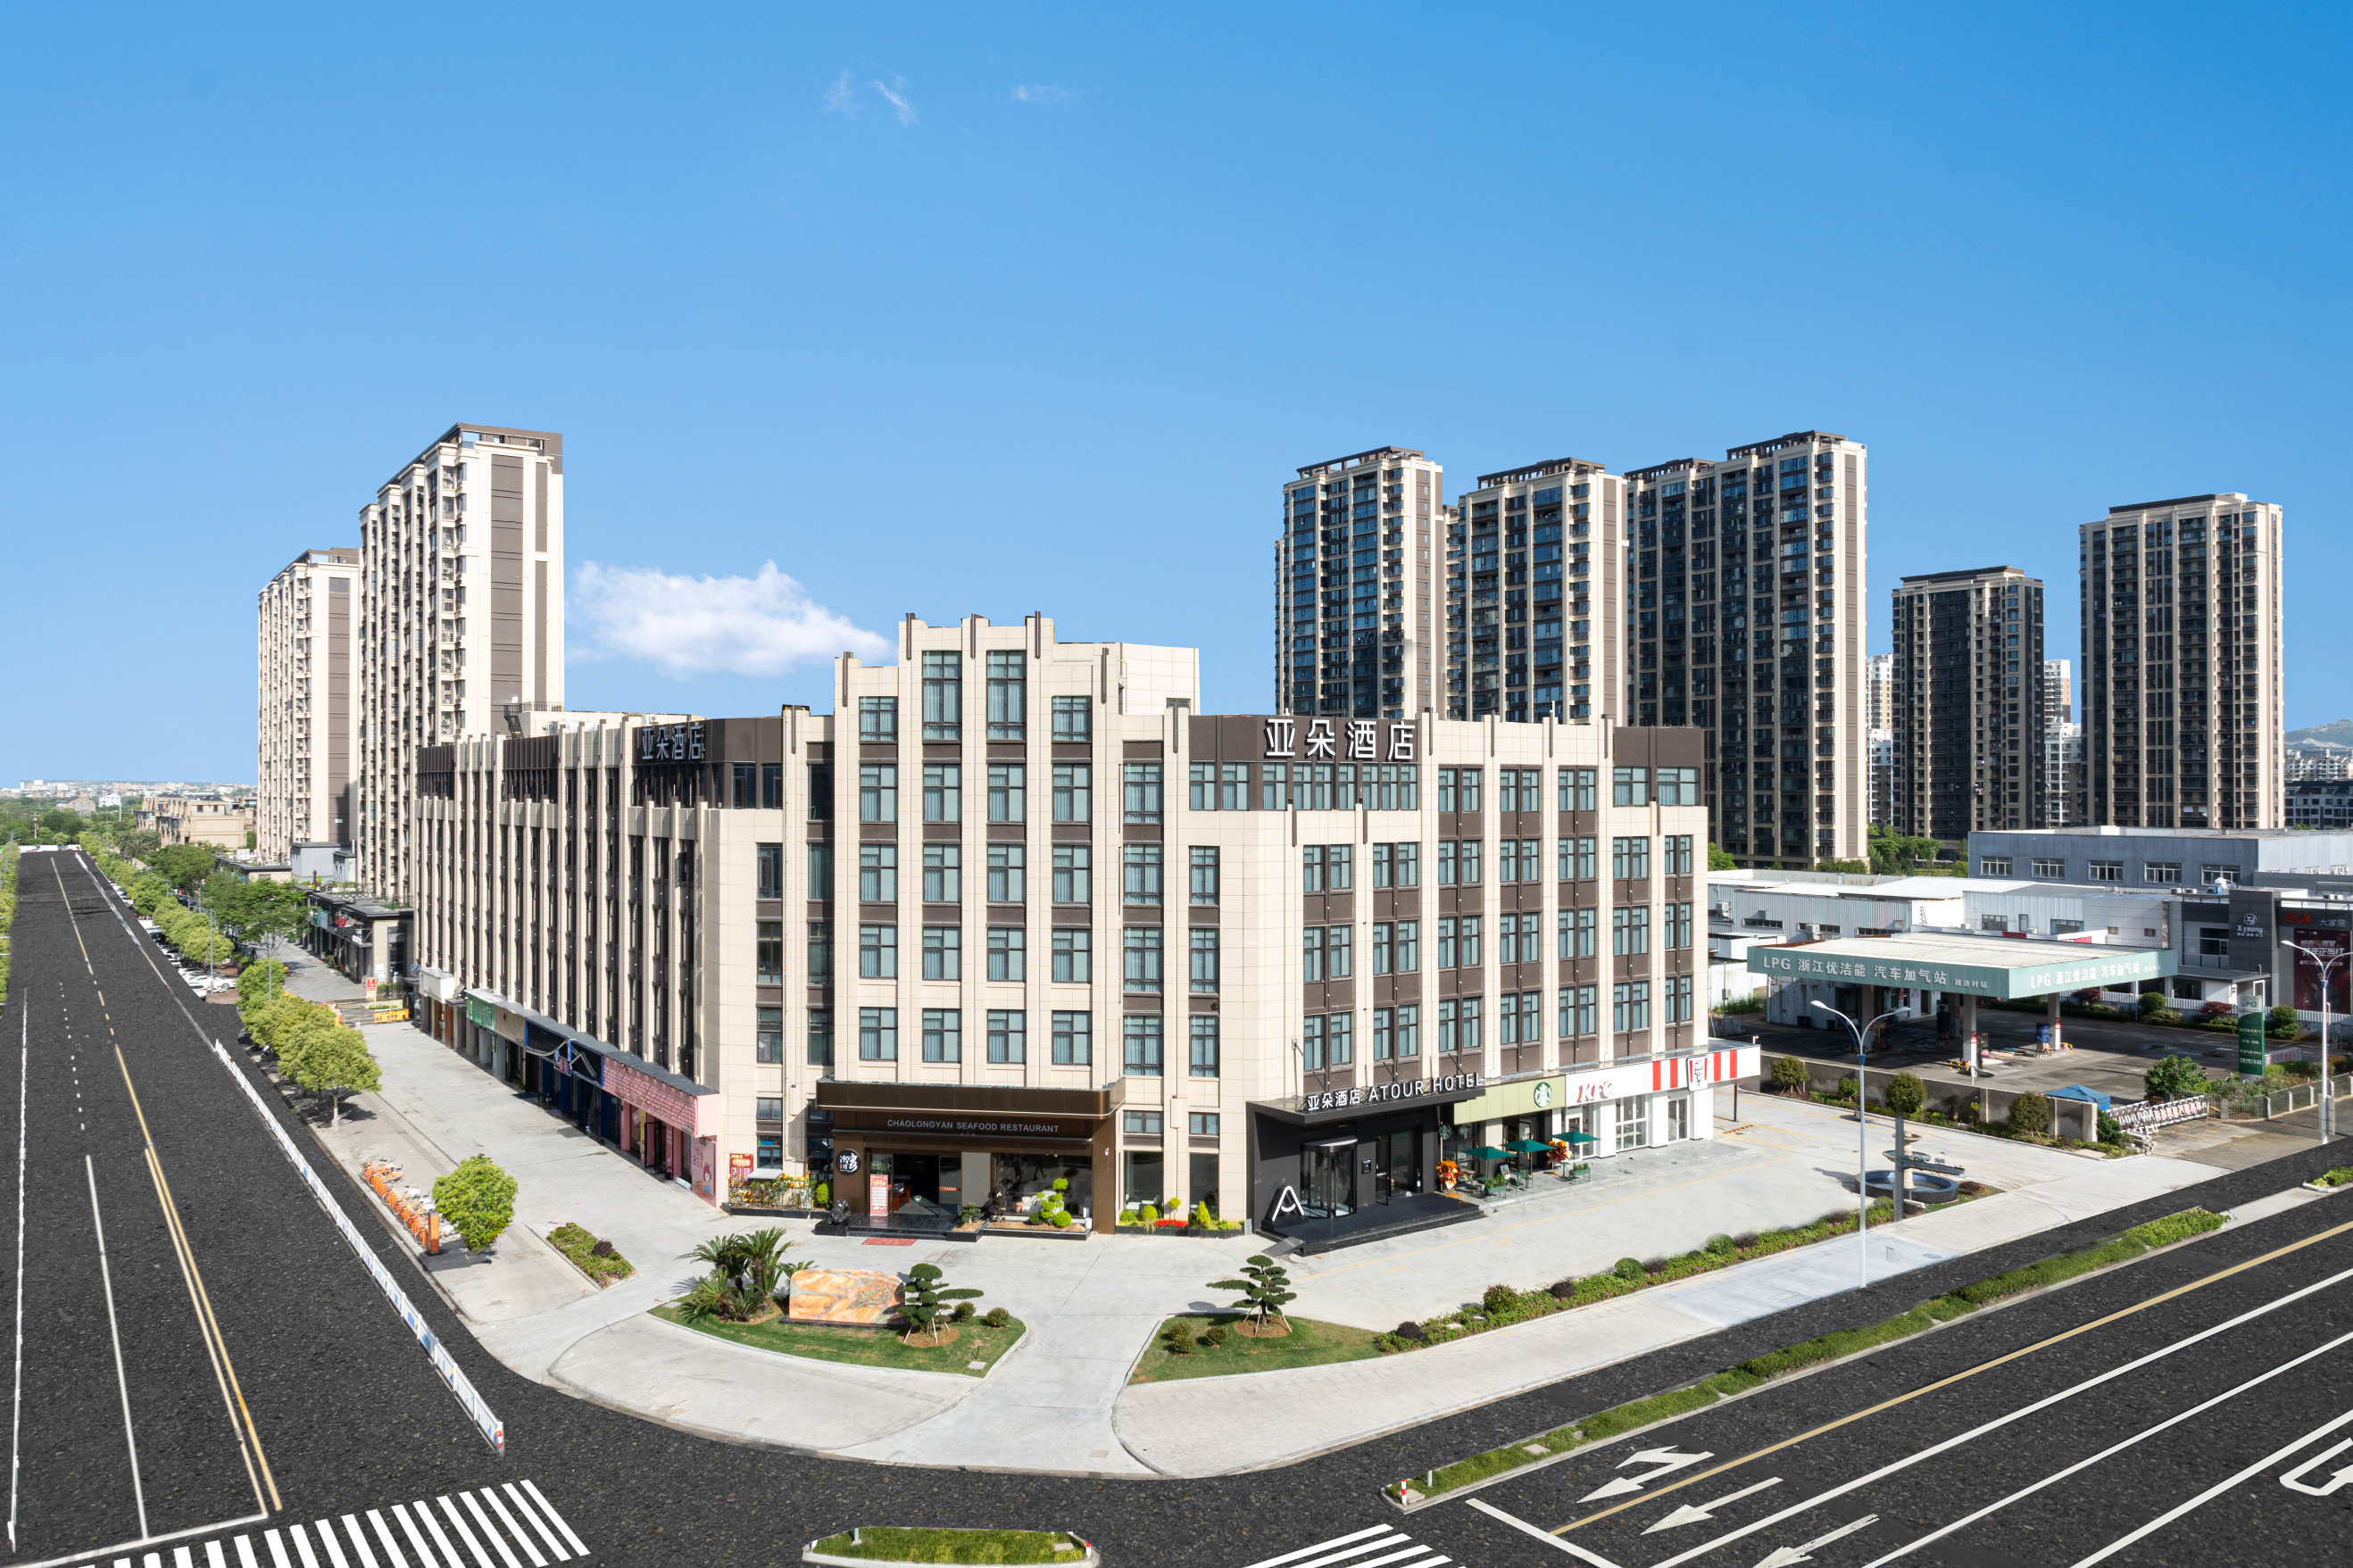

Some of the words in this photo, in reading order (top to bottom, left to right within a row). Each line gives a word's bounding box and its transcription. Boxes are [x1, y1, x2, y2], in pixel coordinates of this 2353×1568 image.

[642, 721, 704, 760] 亚朵酒店
[1266, 718, 1416, 760] 亚朵酒店
[1762, 956, 1792, 970] LPG
[1798, 958, 1867, 978] 浙江优洁能
[1874, 965, 1947, 985] 汽车加气站
[2030, 974, 2051, 989] LPG
[2056, 967, 2097, 984] 浙江优洁能
[2241, 1000, 2257, 1008] LPG
[1307, 1088, 1360, 1111] 亚朵酒店
[1368, 1080, 1424, 1103] ATOUR
[1433, 1072, 1484, 1093] HOTEL
[1577, 1081, 1614, 1103] KFC
[886, 1119, 953, 1129] CHAOLONGYAN
[956, 1122, 998, 1132] SEAFOOD
[1000, 1123, 1060, 1133] RESTAURANT
